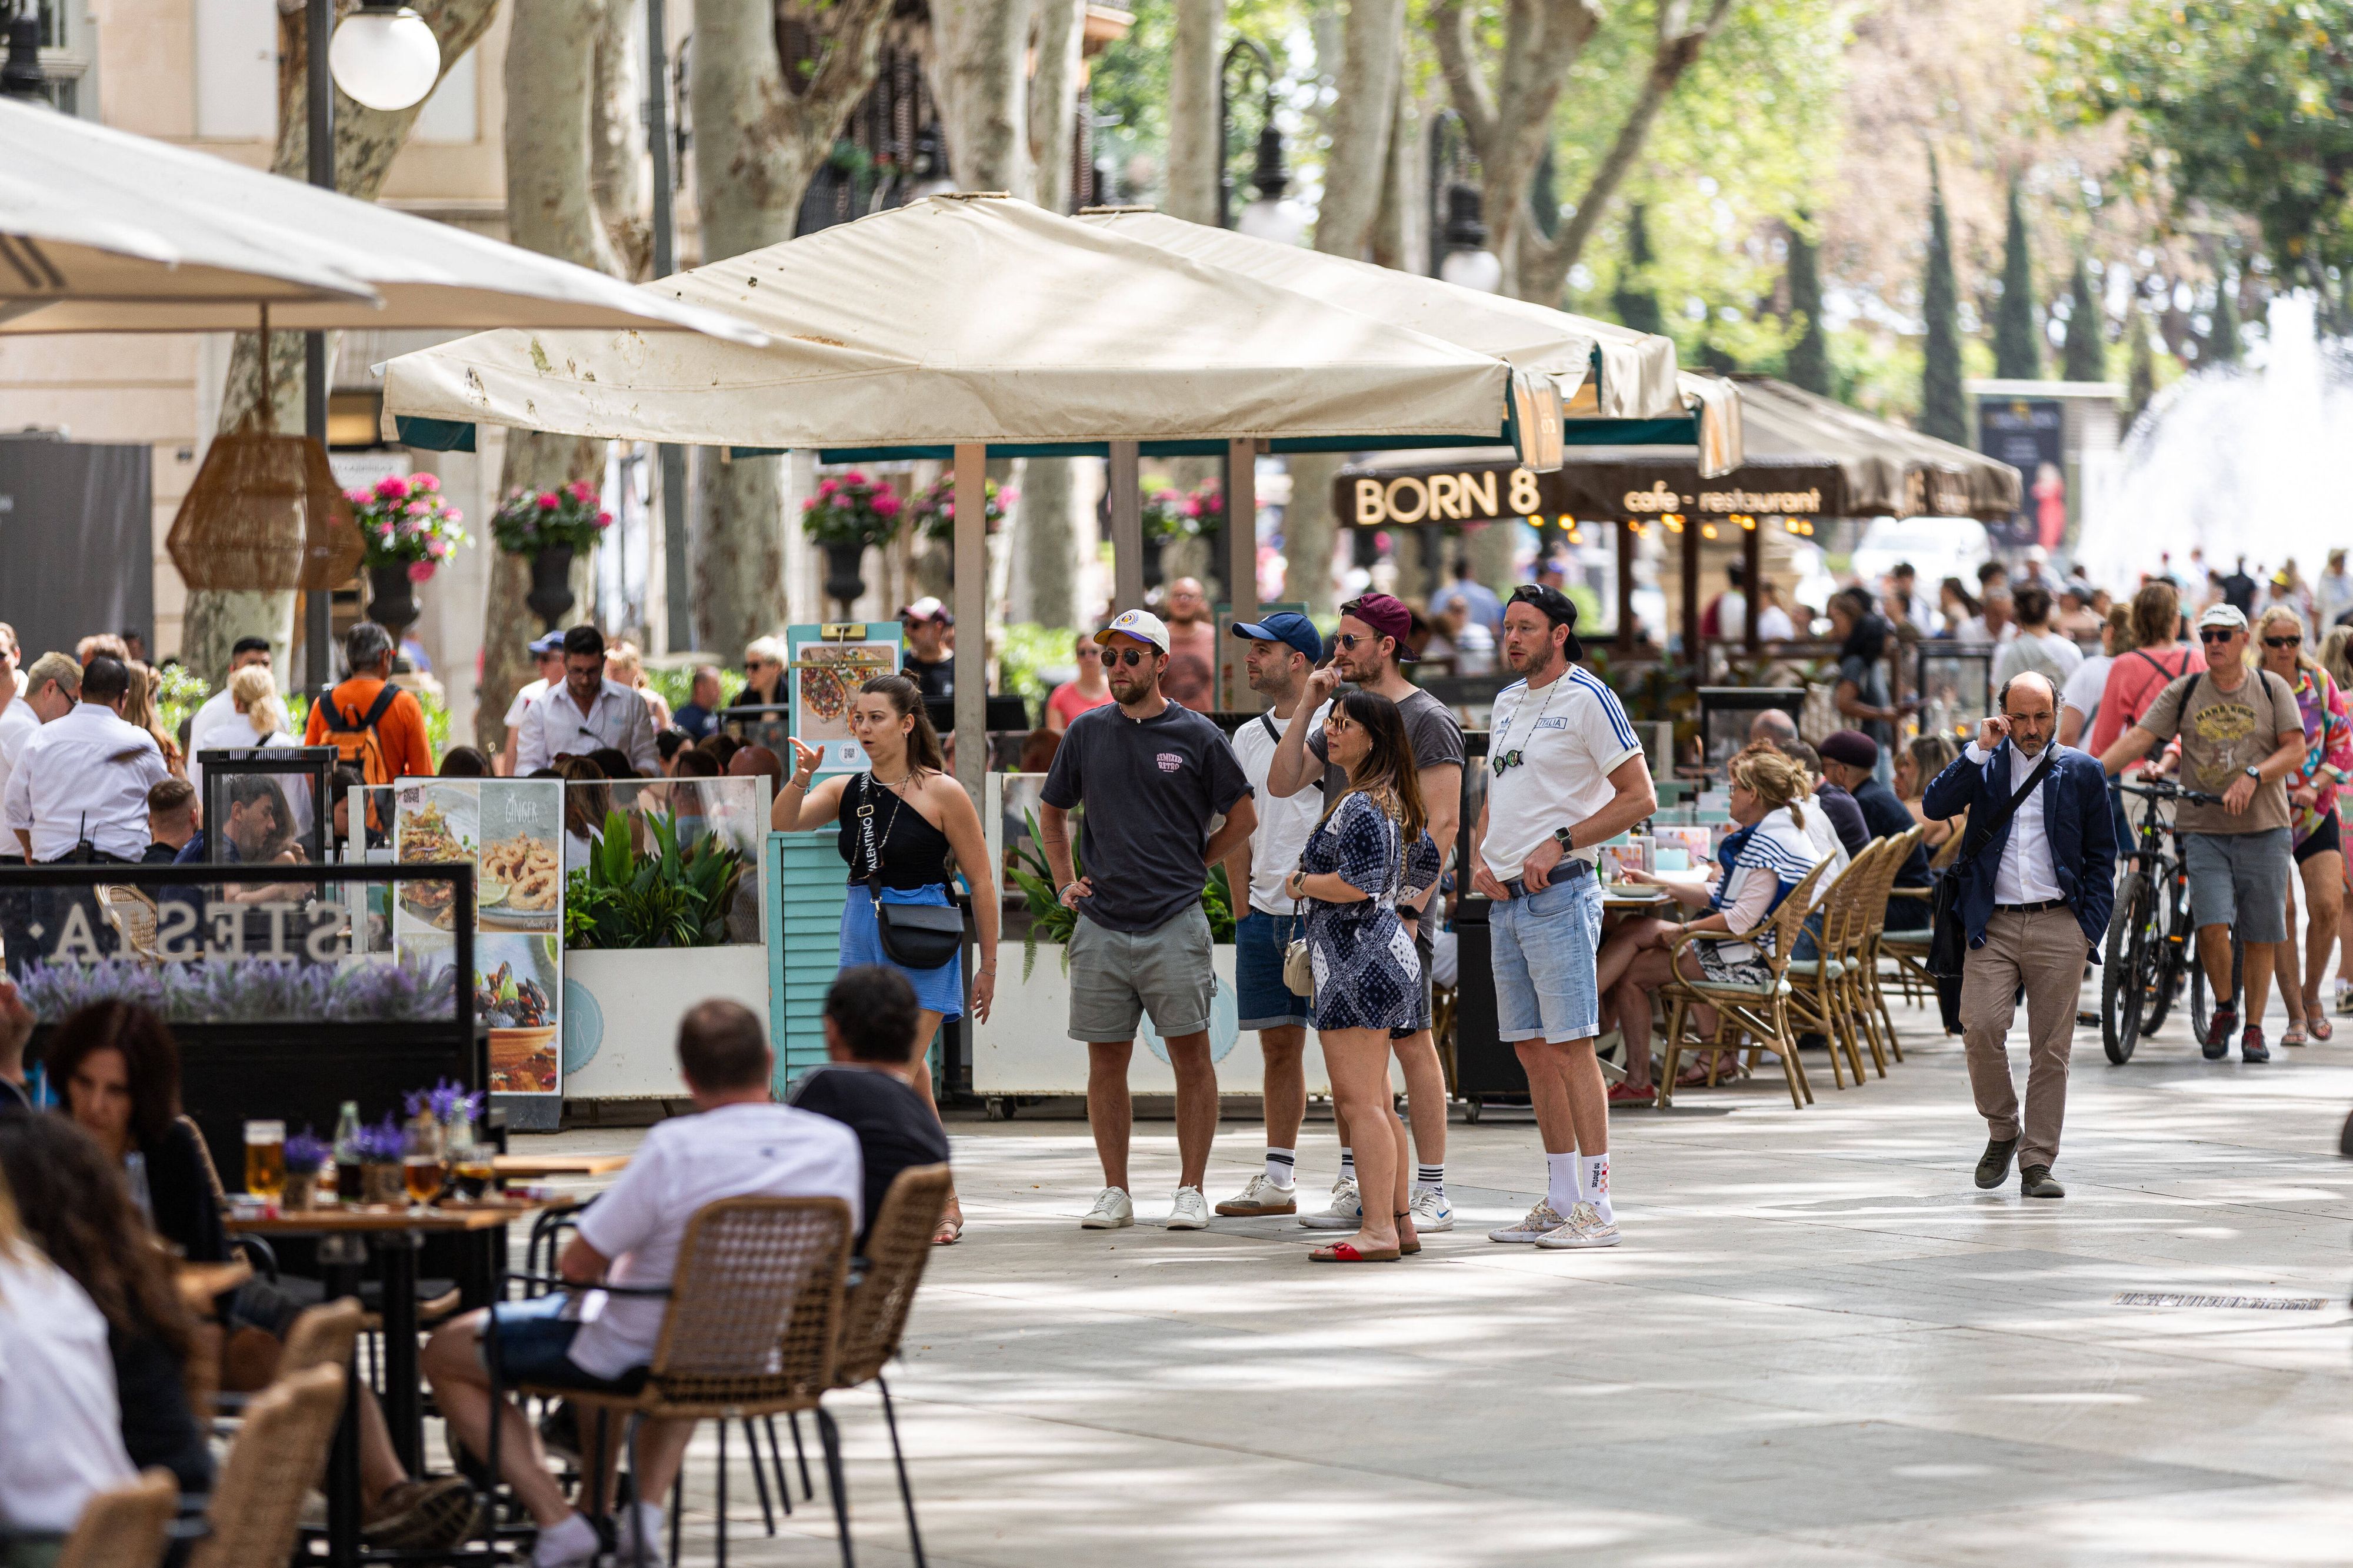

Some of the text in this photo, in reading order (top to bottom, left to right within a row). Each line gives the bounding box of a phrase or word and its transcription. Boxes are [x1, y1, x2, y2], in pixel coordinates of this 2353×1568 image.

[1355, 468, 1541, 525] BORN 8
[1624, 480, 1680, 513] cafe
[1699, 488, 1822, 513] restaurant
[1539, 719, 1561, 727] ITALIA
[1156, 753, 1182, 763] REMIXED
[1158, 762, 1179, 770] RETRO
[506, 798, 538, 823] GINGER
[1592, 1170, 1600, 1187] photos
